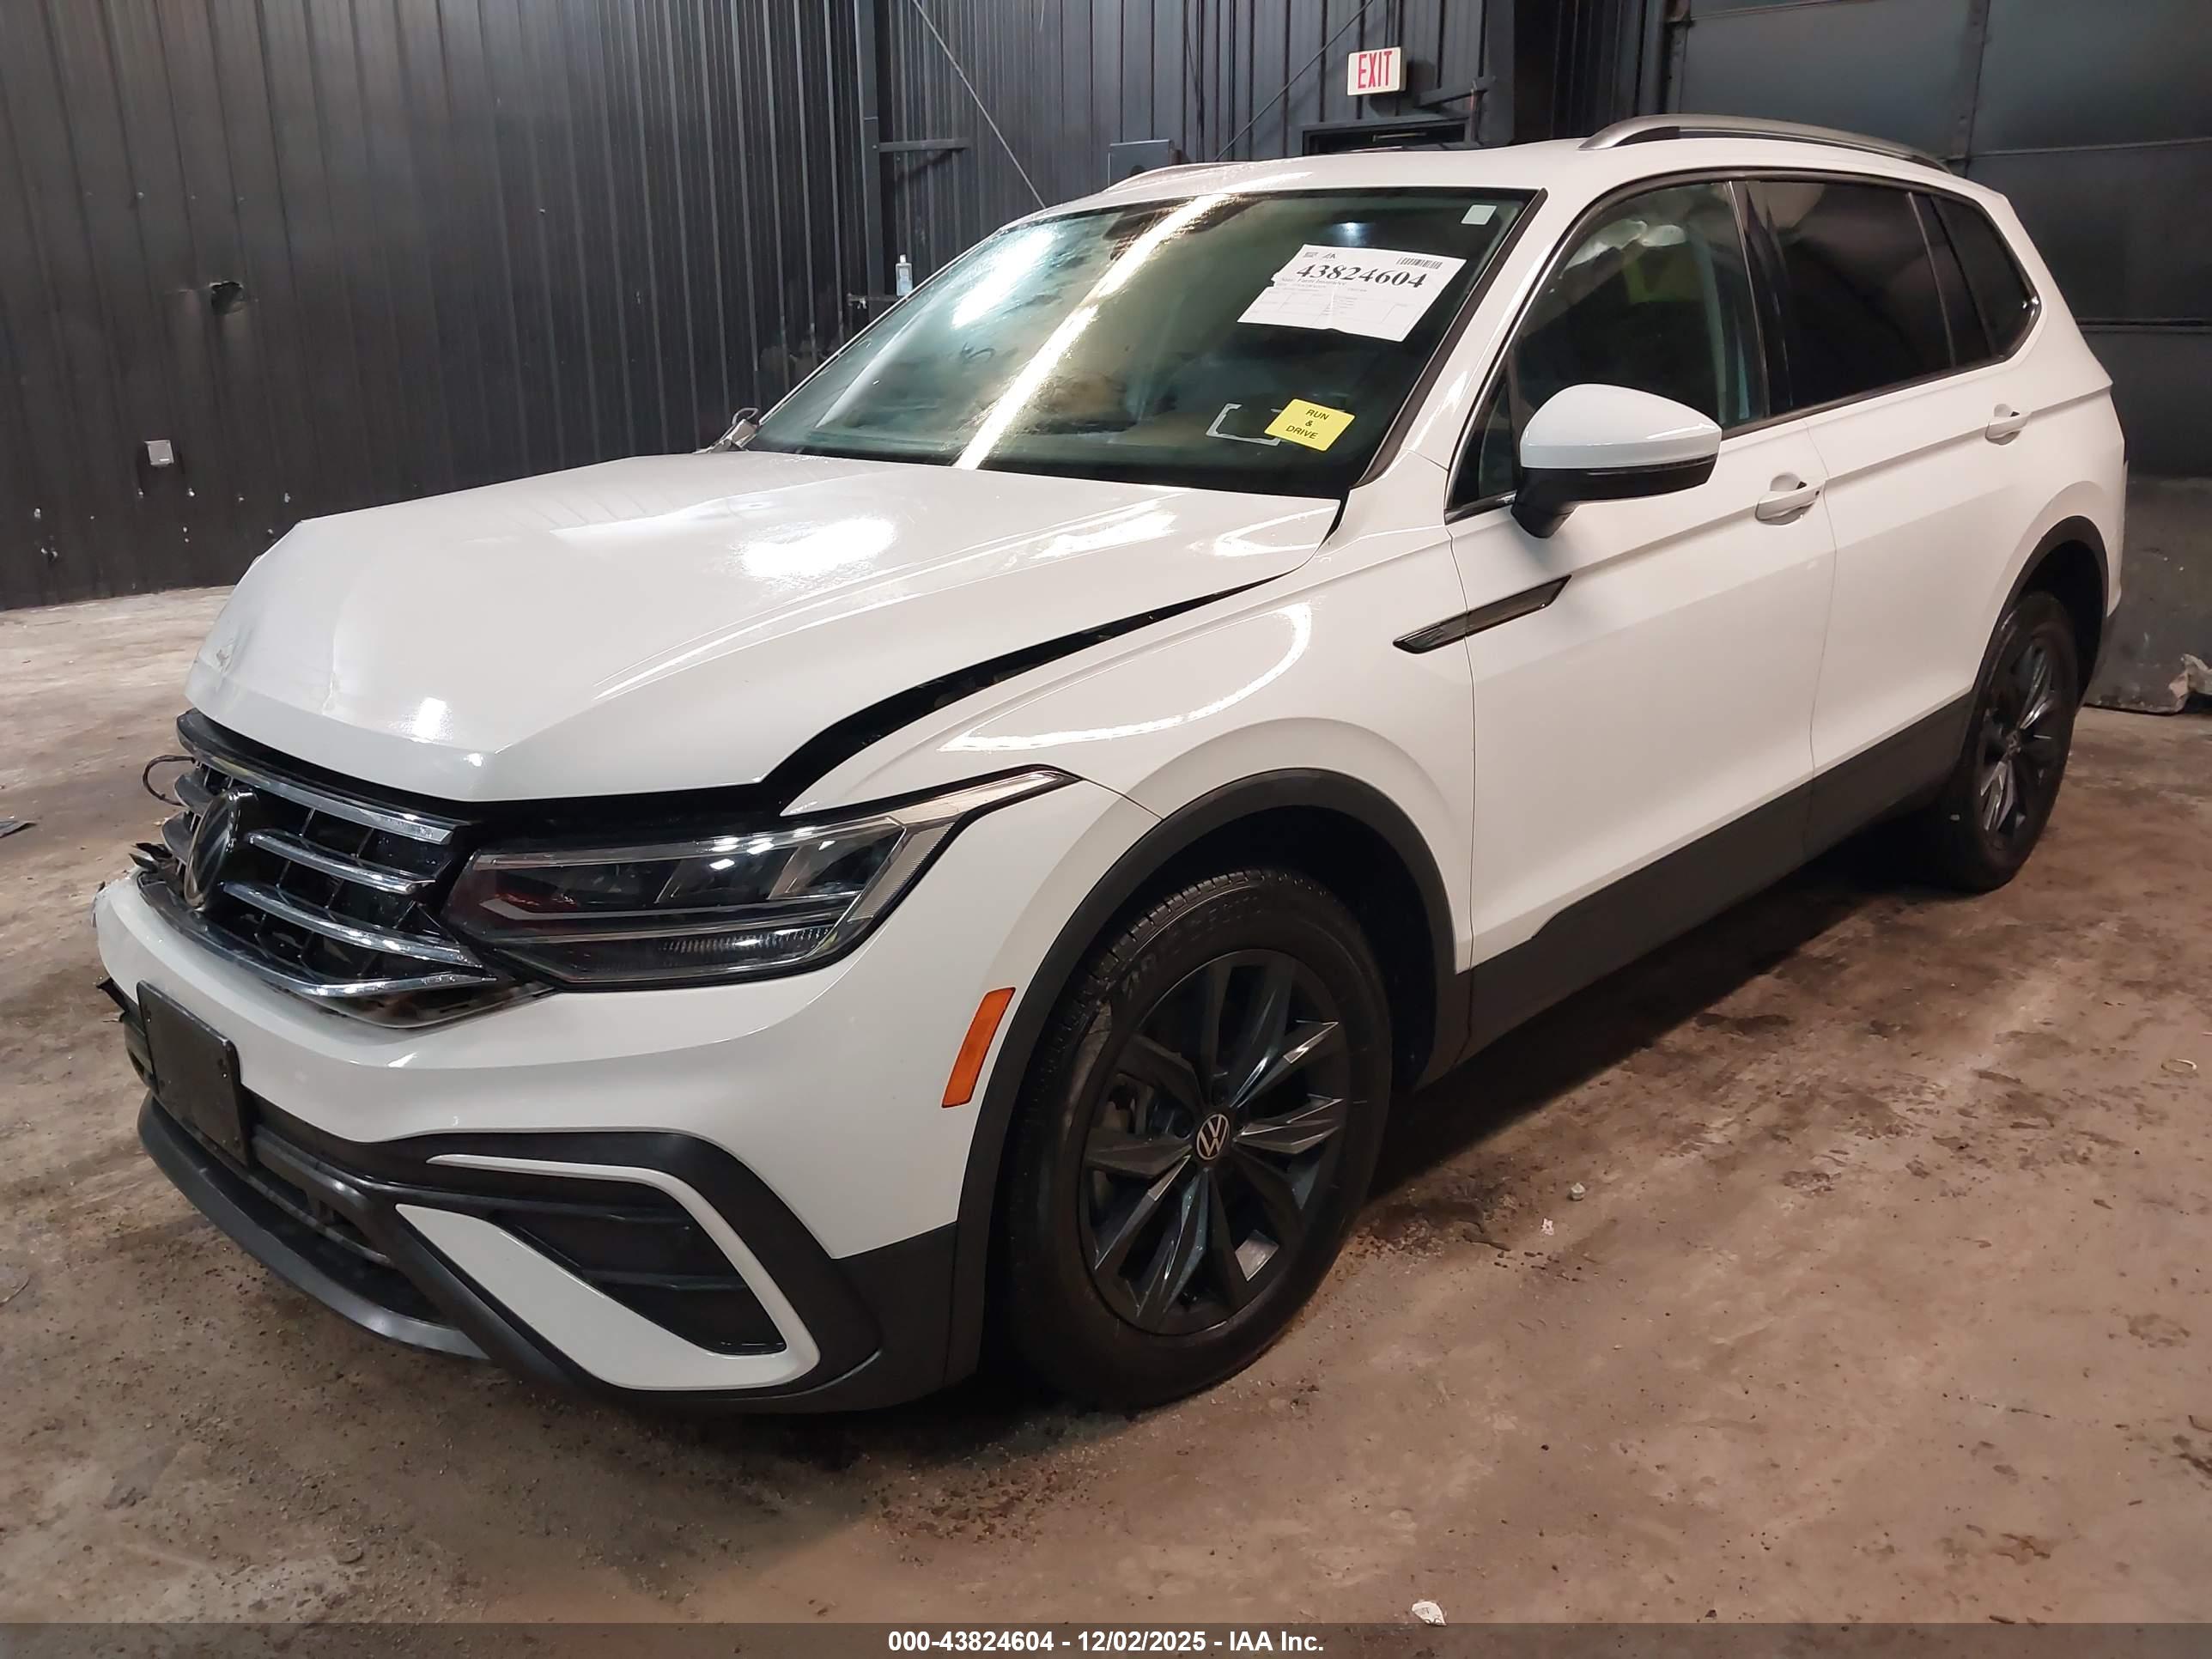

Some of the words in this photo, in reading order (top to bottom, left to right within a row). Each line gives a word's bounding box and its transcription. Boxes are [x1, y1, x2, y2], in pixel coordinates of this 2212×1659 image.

[1358, 51, 1393, 89] EXIT
[1296, 264, 1427, 289] 43824604
[1305, 409, 1330, 420] RUN
[1285, 425, 1319, 440] DRIVE
